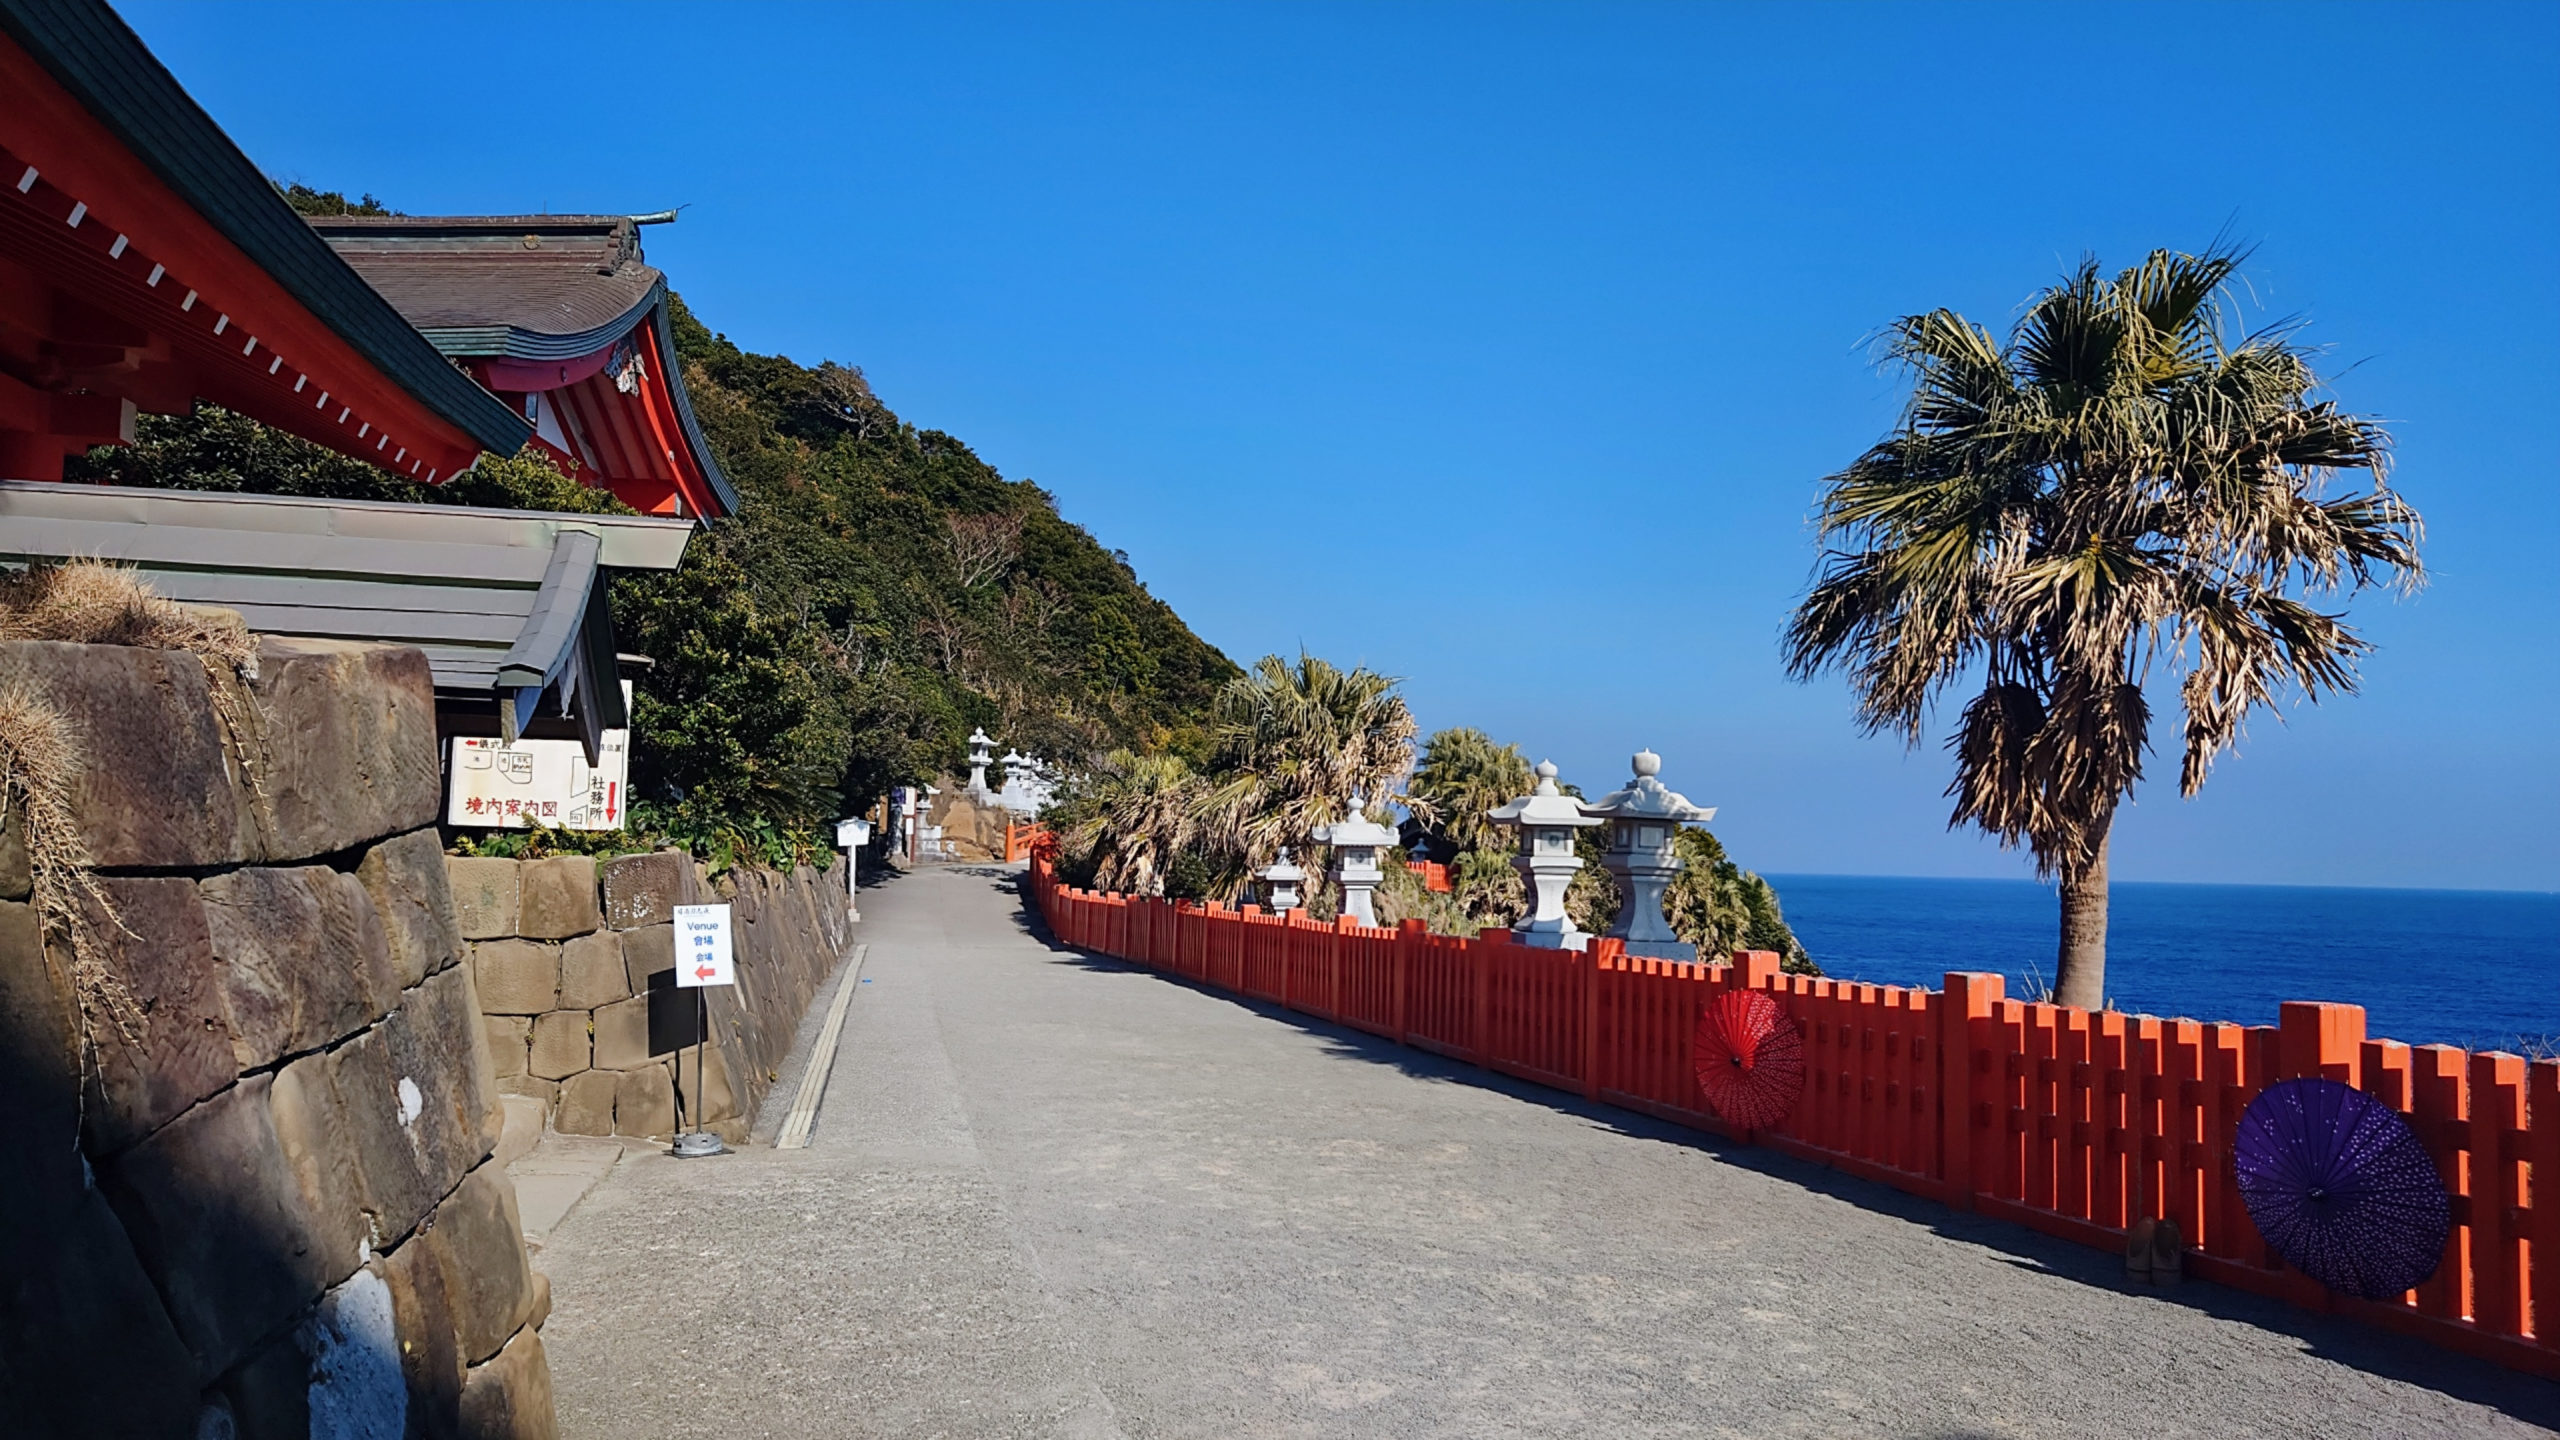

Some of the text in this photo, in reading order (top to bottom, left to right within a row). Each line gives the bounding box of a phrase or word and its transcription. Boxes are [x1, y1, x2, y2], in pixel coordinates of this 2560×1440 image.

[465, 797, 557, 817] 境内案内図
[590, 776, 605, 821] 社務所
[687, 922, 718, 931] Venue
